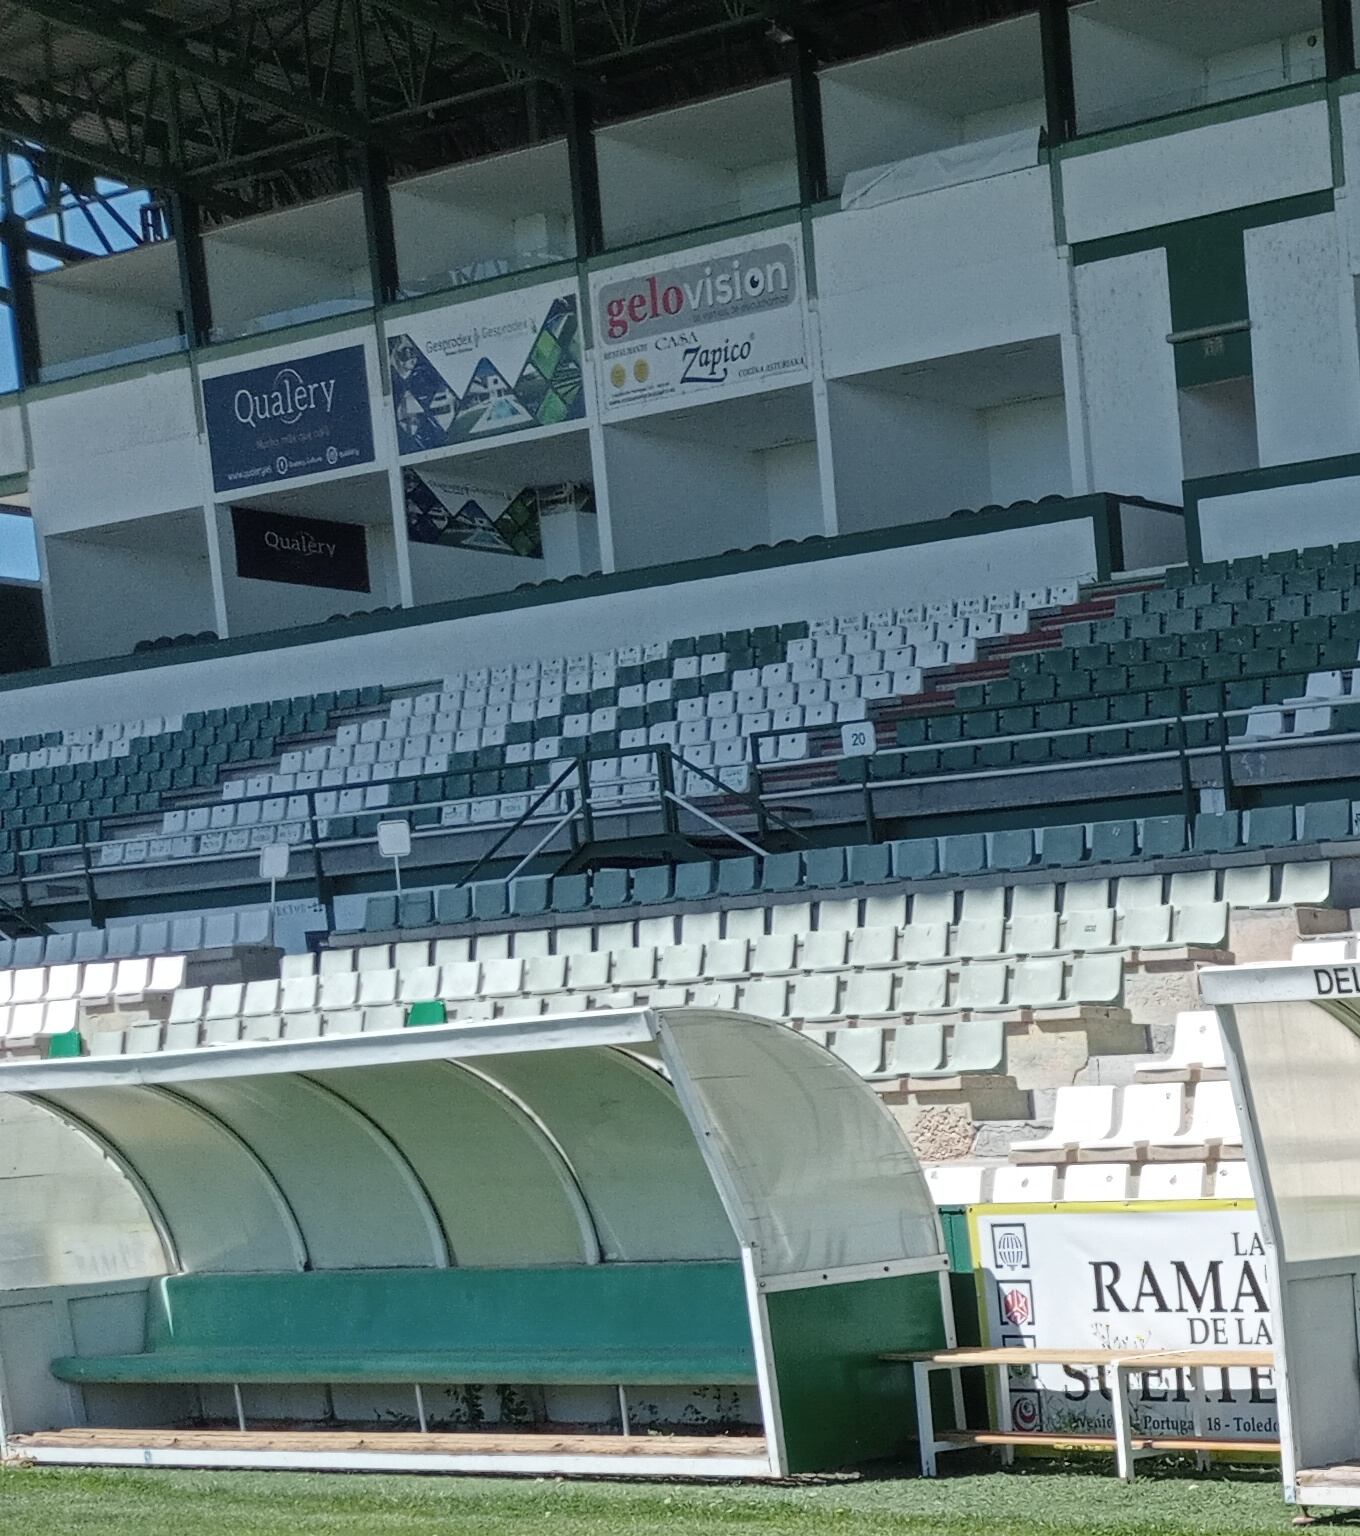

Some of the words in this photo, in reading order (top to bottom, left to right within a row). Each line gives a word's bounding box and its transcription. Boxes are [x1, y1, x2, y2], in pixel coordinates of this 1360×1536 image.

[607, 259, 789, 340] gelovision
[655, 331, 699, 351] CASA
[680, 338, 752, 385] Zapico
[234, 378, 336, 429] Qualery
[263, 529, 338, 559] Qualery
[851, 732, 866, 747] 20
[1231, 1232, 1265, 1256] LA
[1088, 1260, 1270, 1313] RAMA
[1187, 1317, 1229, 1345] DE
[1235, 1317, 1273, 1345] LA
[1143, 1415, 1195, 1435] Portuga
[1207, 1417, 1221, 1431] 18
